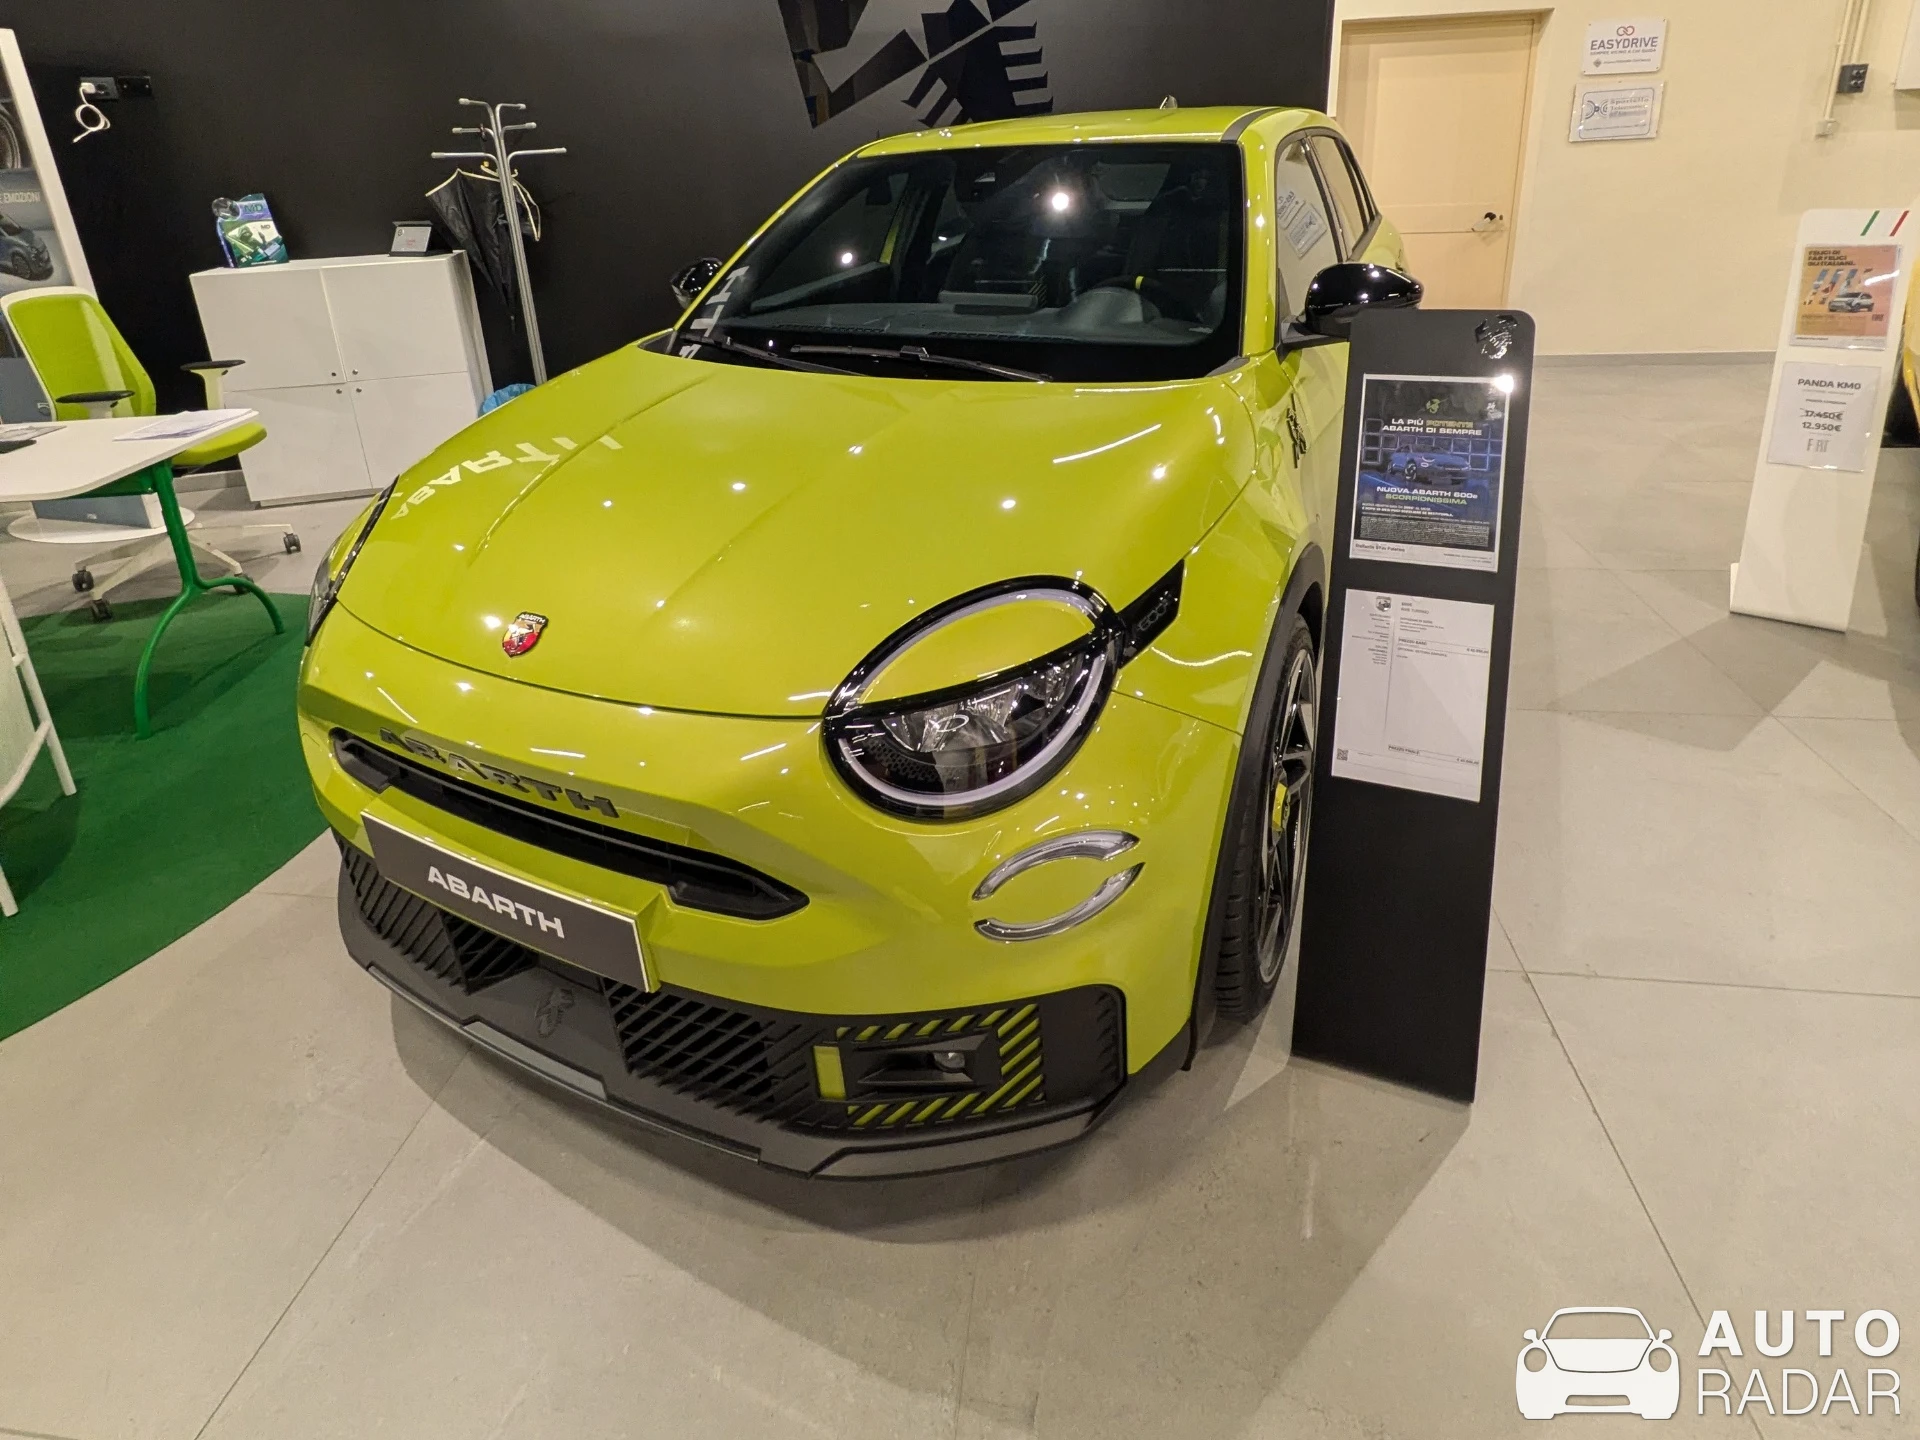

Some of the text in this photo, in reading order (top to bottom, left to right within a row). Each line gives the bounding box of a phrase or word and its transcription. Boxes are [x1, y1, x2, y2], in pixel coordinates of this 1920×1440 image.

[1590, 36, 1659, 51] EASYDRIVE
[1797, 378, 1834, 389] PANDA
[1407, 418, 1424, 426] PIÙ
[1802, 421, 1841, 432] 12.950€
[1382, 425, 1423, 433] ABARTH
[1439, 428, 1482, 436] SEMPRE
[1807, 438, 1830, 452] FAT
[1376, 486, 1478, 499] NUOVA ABARTH 600e
[1385, 494, 1467, 505] SCORPIONISSIMA
[519, 613, 546, 623] ABARTH
[379, 726, 620, 819] ABARTH
[427, 865, 565, 939] ABARTH
